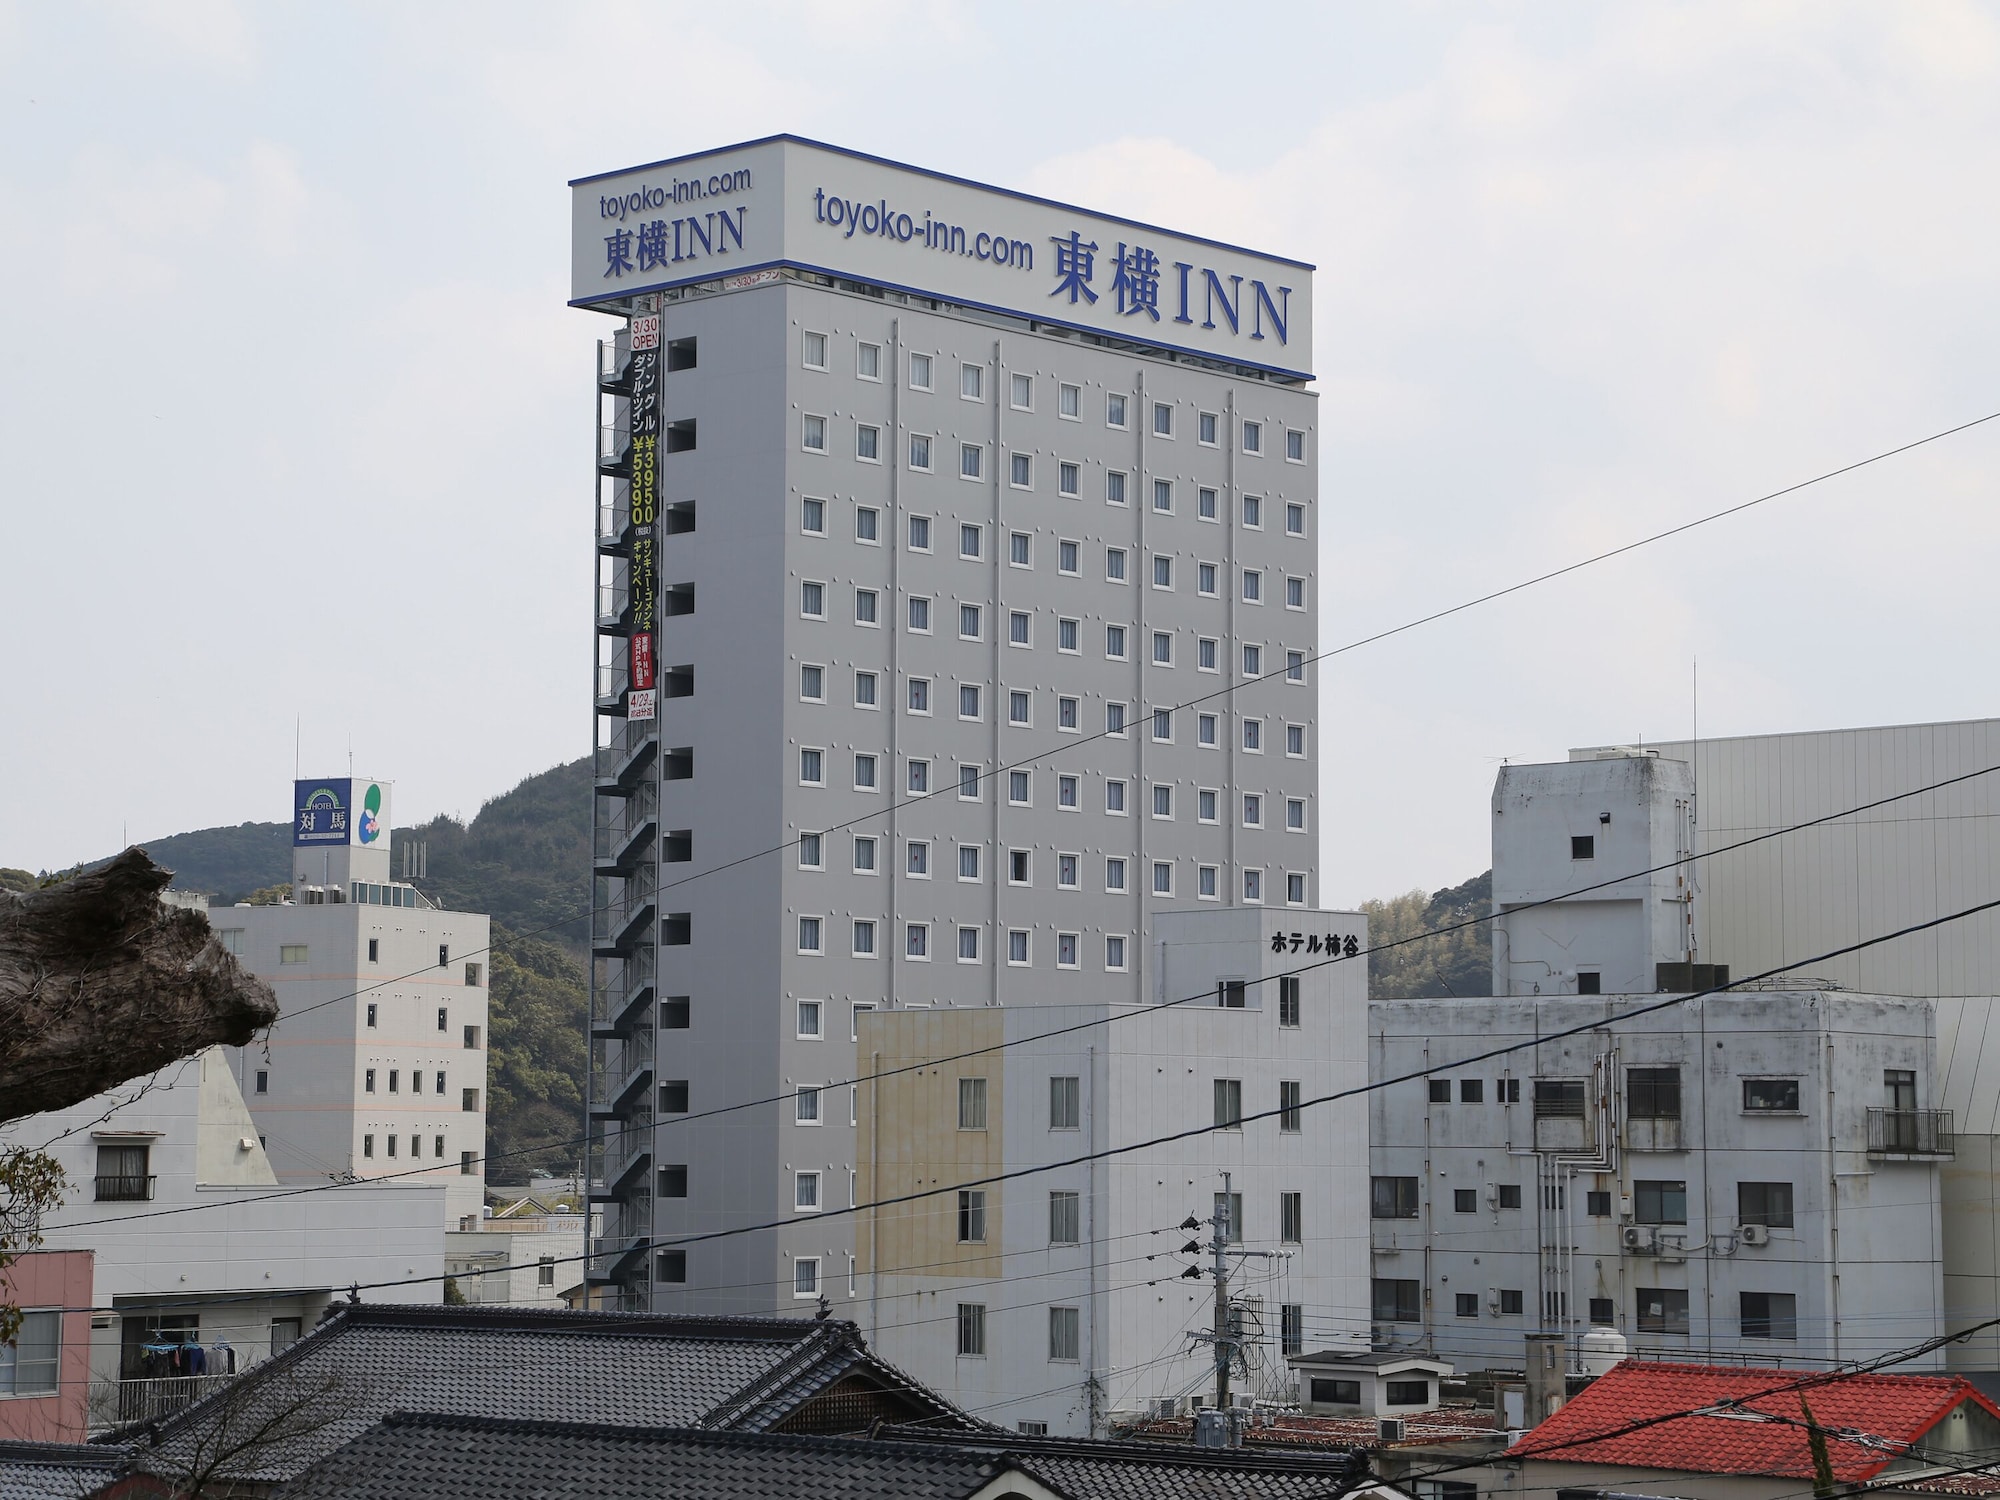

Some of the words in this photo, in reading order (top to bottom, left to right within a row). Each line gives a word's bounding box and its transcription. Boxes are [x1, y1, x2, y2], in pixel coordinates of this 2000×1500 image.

[599, 165, 752, 220] toyoko-inn.com
[815, 187, 1034, 270] toyoko-inn.com
[603, 206, 747, 278] 東横INN
[633, 318, 658, 334] 3/30
[1049, 231, 1292, 346] 東横INN
[633, 333, 658, 349] OPEN
[632, 354, 646, 433] ダブル・ツイン
[644, 353, 656, 431] シングル
[632, 436, 643, 525] ¥5390
[644, 434, 655, 523] ¥3950
[1272, 931, 1359, 957] ホテル柿谷
